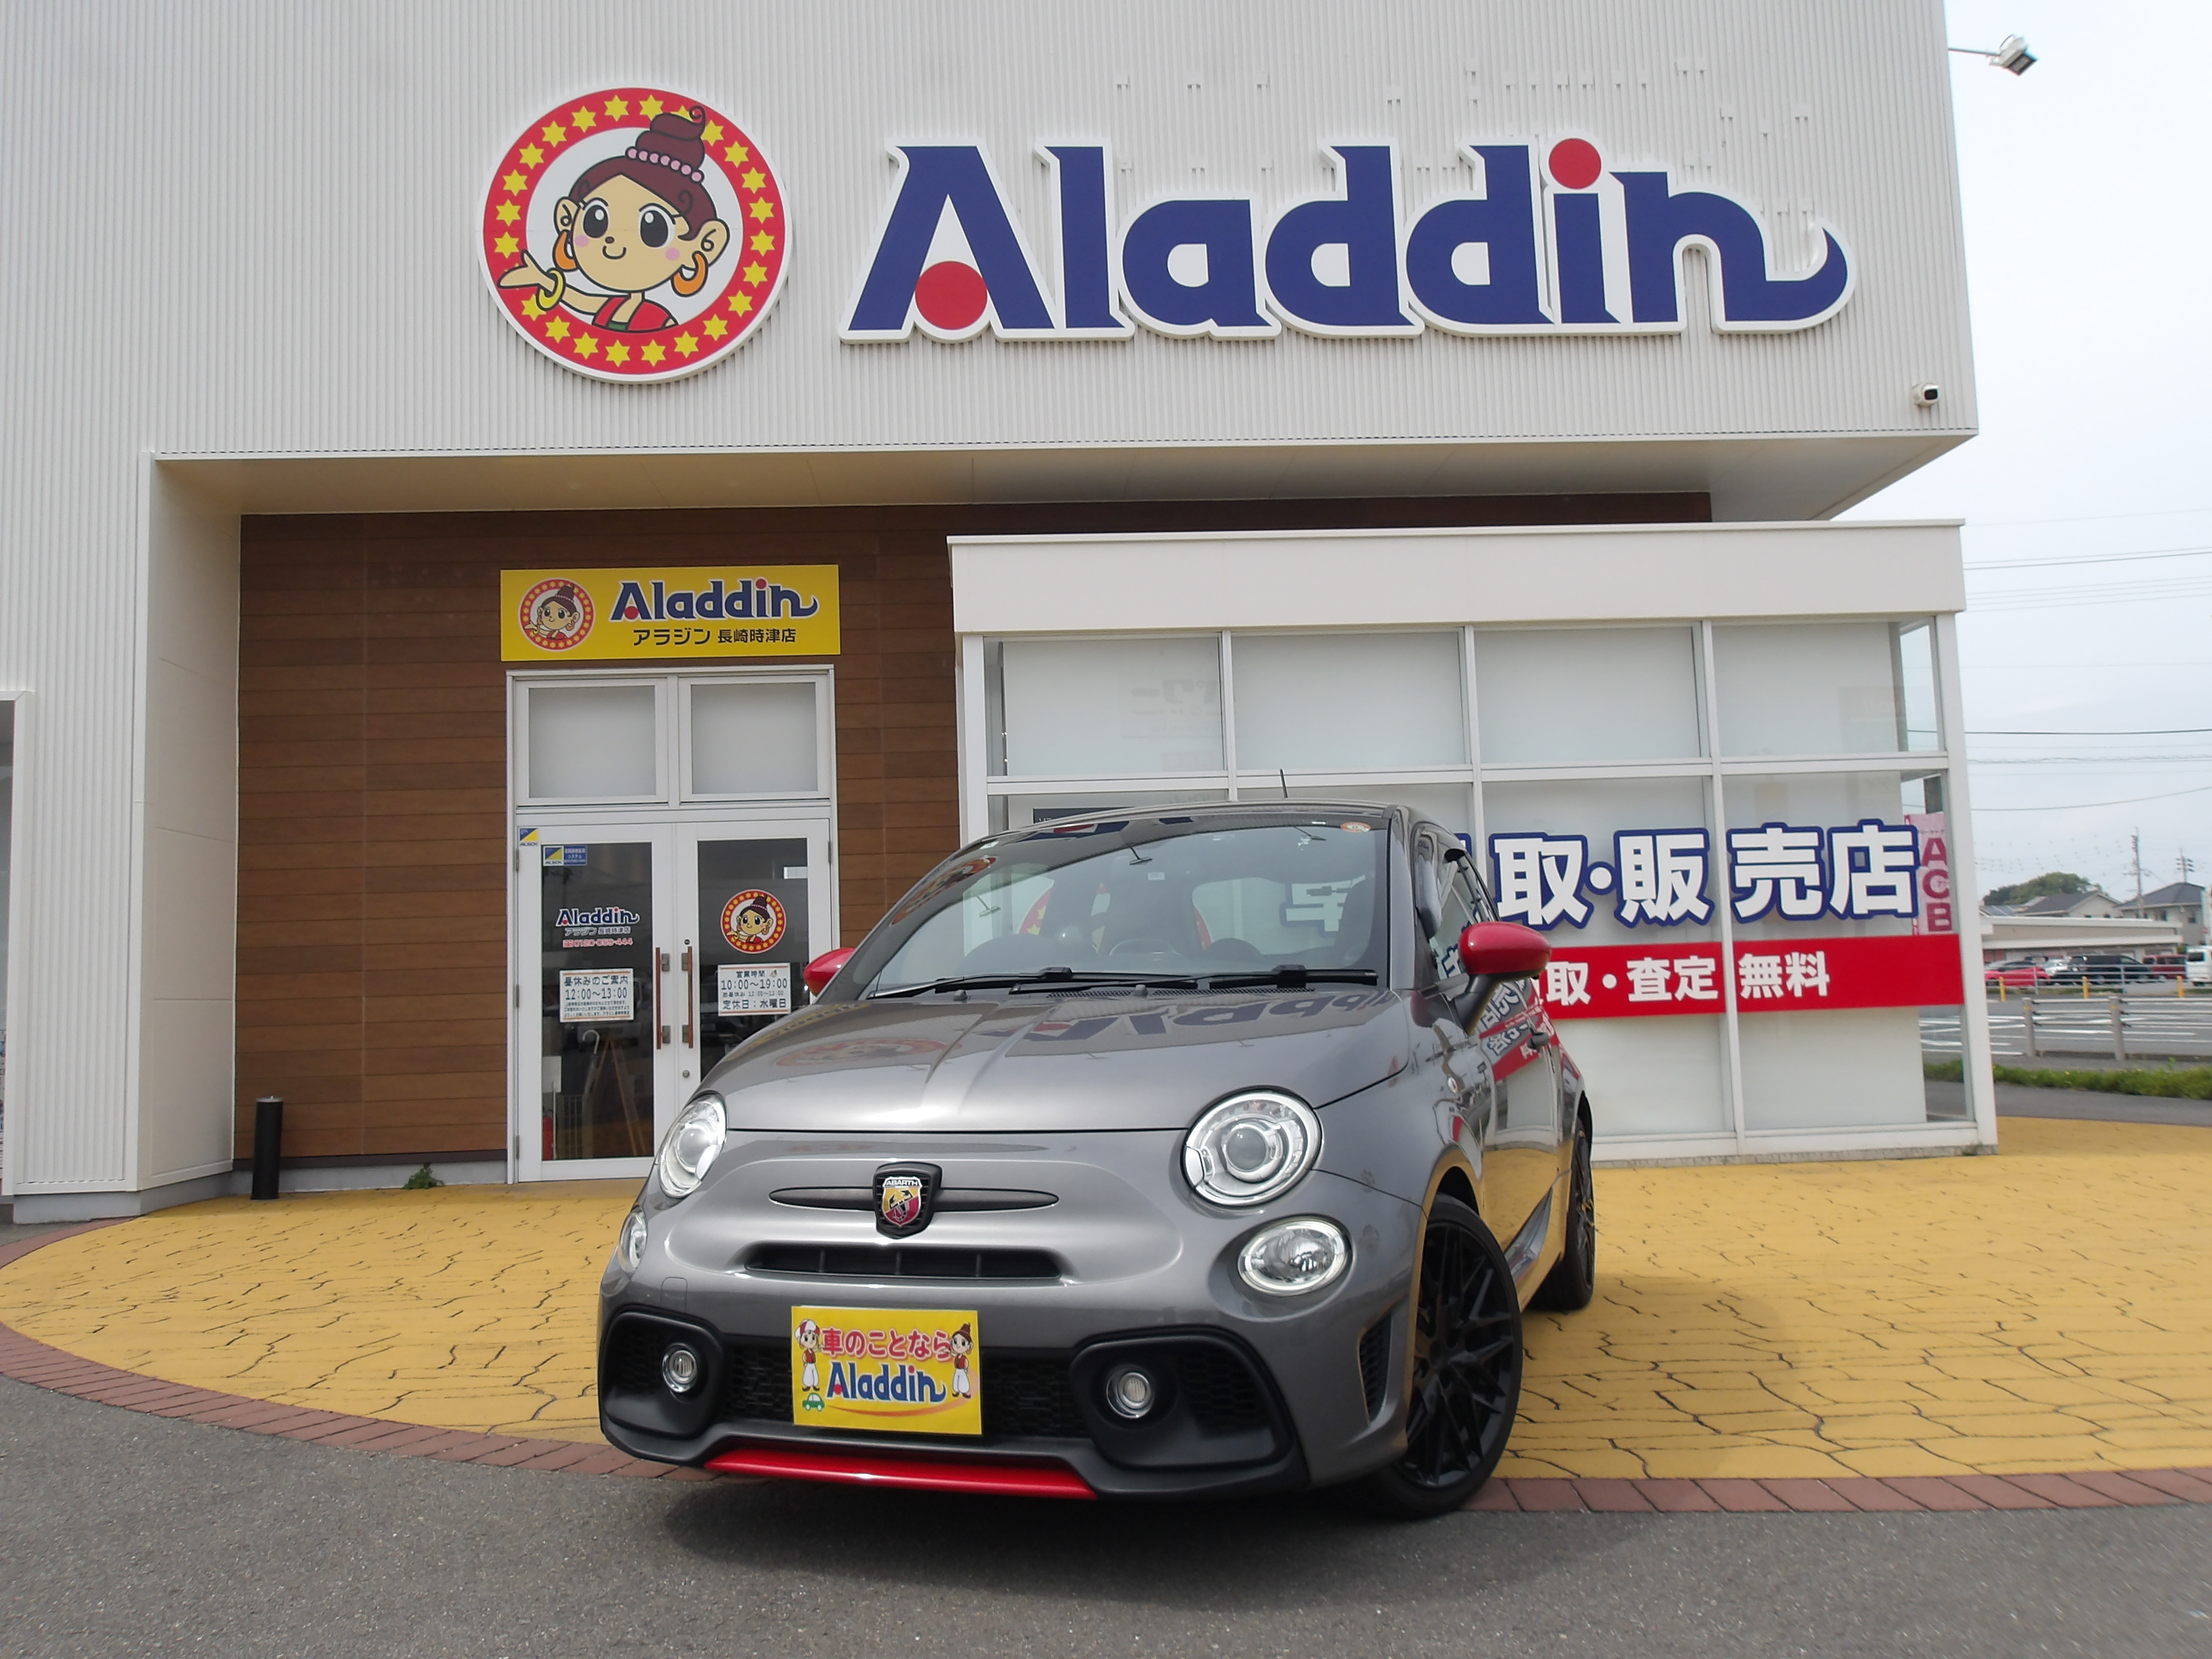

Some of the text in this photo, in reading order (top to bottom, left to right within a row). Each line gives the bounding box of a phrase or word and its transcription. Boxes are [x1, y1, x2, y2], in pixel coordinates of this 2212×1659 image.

[842, 135, 1851, 333] Aladdin
[610, 578, 818, 621] Aladdin
[633, 627, 796, 646] アラジン 長崎時津店
[1459, 819, 1920, 929] 取・販売店
[556, 906, 640, 926] Aladdin
[565, 927, 597, 937] アラジン
[564, 975, 628, 986] 昼休みのご案内
[736, 970, 765, 978] 営業時間
[820, 1327, 952, 1361] 車のことなら
[826, 1361, 947, 1403] Aladdin
